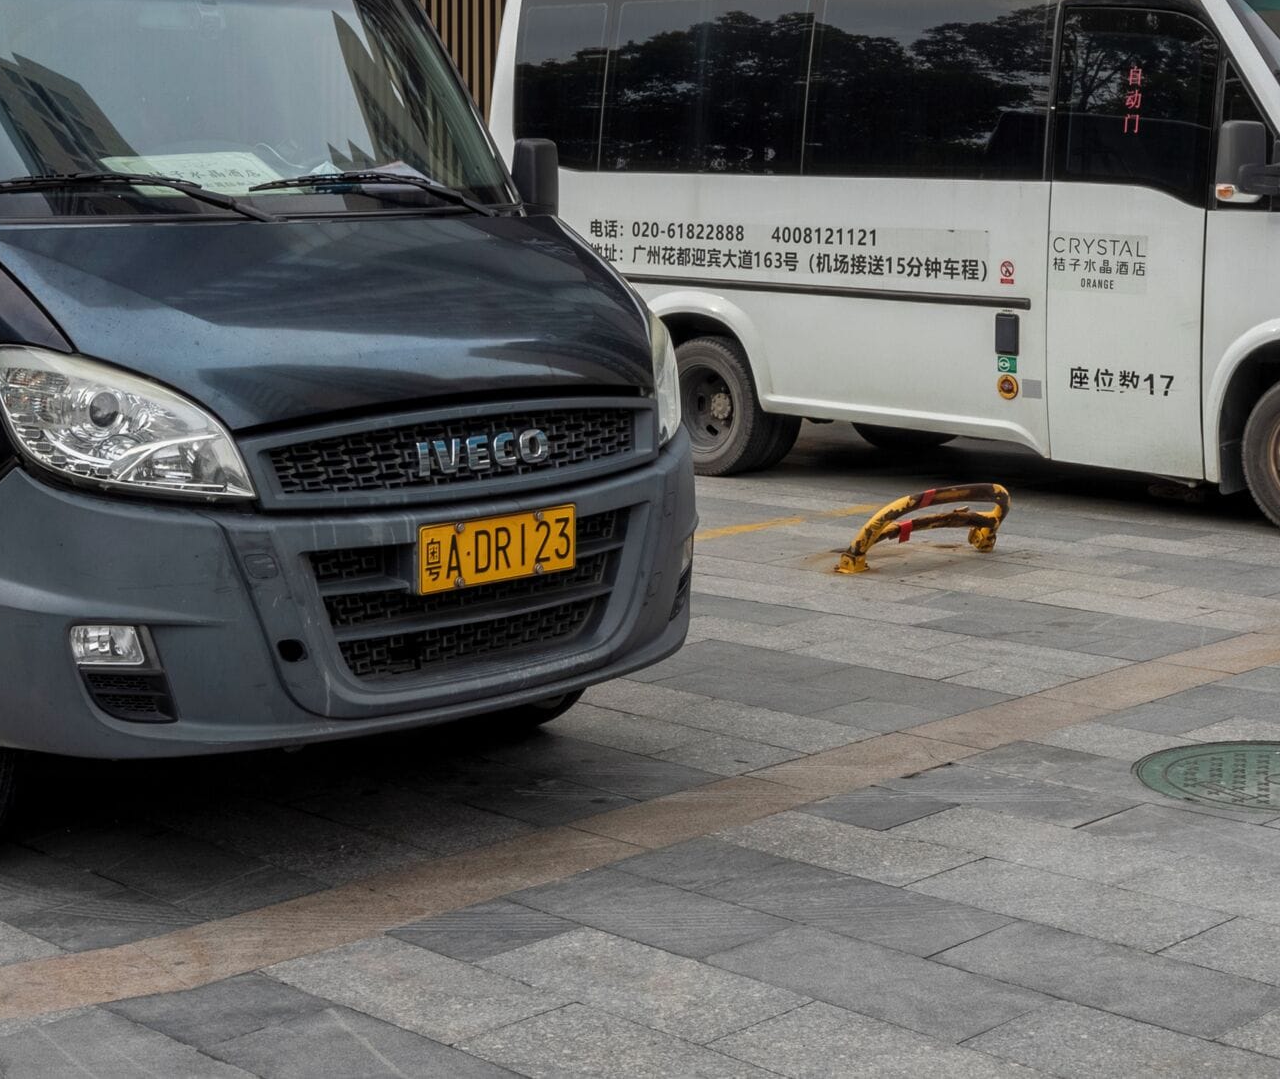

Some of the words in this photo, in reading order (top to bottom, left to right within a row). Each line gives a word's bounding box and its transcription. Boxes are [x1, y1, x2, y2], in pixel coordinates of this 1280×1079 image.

[1124, 66, 1142, 133] 自动门
[771, 226, 877, 246] 4008121121
[1053, 236, 1147, 258] CRYSTAL
[1053, 257, 1146, 277] 桔子水晶酒店
[1081, 277, 1114, 290] ORANGE
[1070, 366, 1174, 397] 座位数17
[416, 428, 549, 477] IVECO
